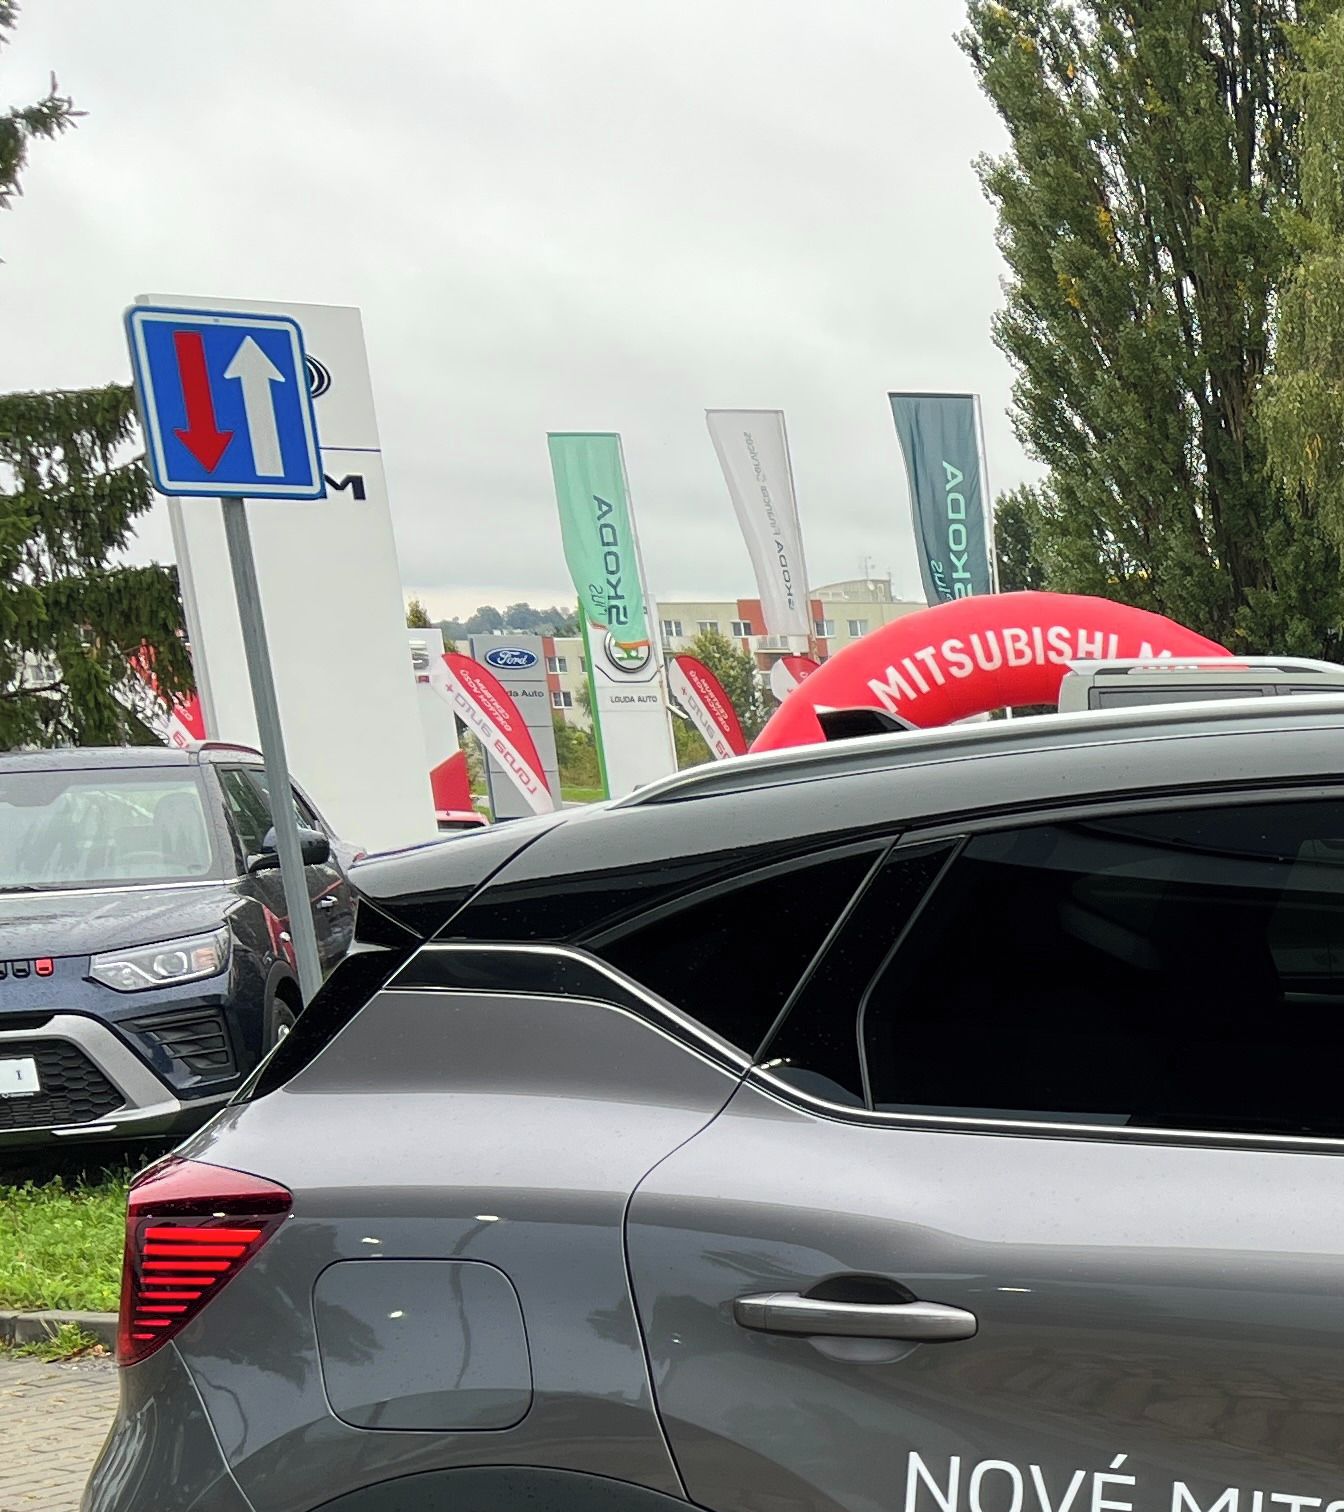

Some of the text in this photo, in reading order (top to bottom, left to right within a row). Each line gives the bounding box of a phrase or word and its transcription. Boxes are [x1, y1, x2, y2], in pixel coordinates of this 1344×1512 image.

[497, 650, 527, 665] Ford
[867, 624, 1118, 714] MITSUBISHI
[521, 688, 545, 698] Auto
[610, 695, 657, 704] LOUDA AUTO
